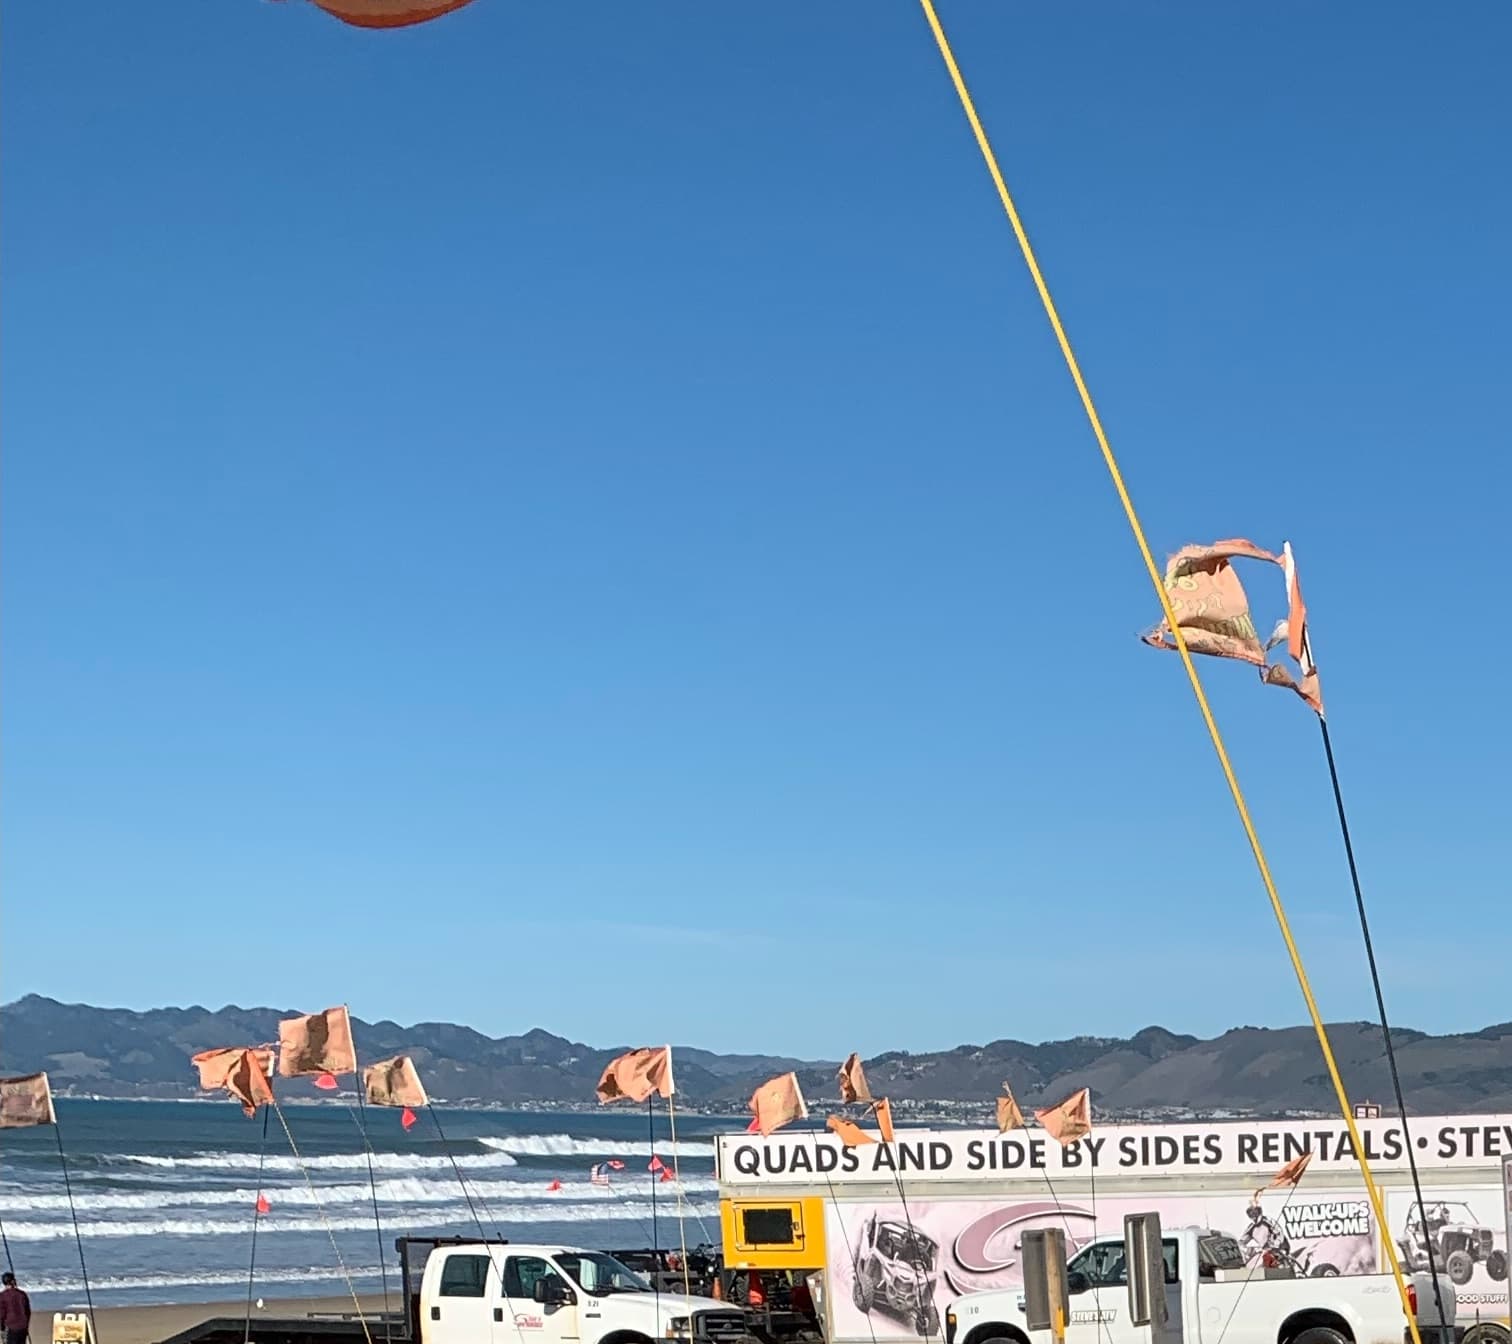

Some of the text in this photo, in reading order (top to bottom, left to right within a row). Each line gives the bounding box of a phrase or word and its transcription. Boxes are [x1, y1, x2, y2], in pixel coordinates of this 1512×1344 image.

[734, 1144, 860, 1176] QUADS
[872, 1141, 952, 1171] AND
[966, 1139, 1046, 1170] SIDE
[1061, 1137, 1106, 1168] BY
[1118, 1133, 1222, 1166] SIDES
[1238, 1128, 1402, 1164] RENTALS
[1283, 1201, 1369, 1222] WALK-UPS
[1285, 1218, 1369, 1239] WELCOME
[1455, 1294, 1479, 1304] OOD
